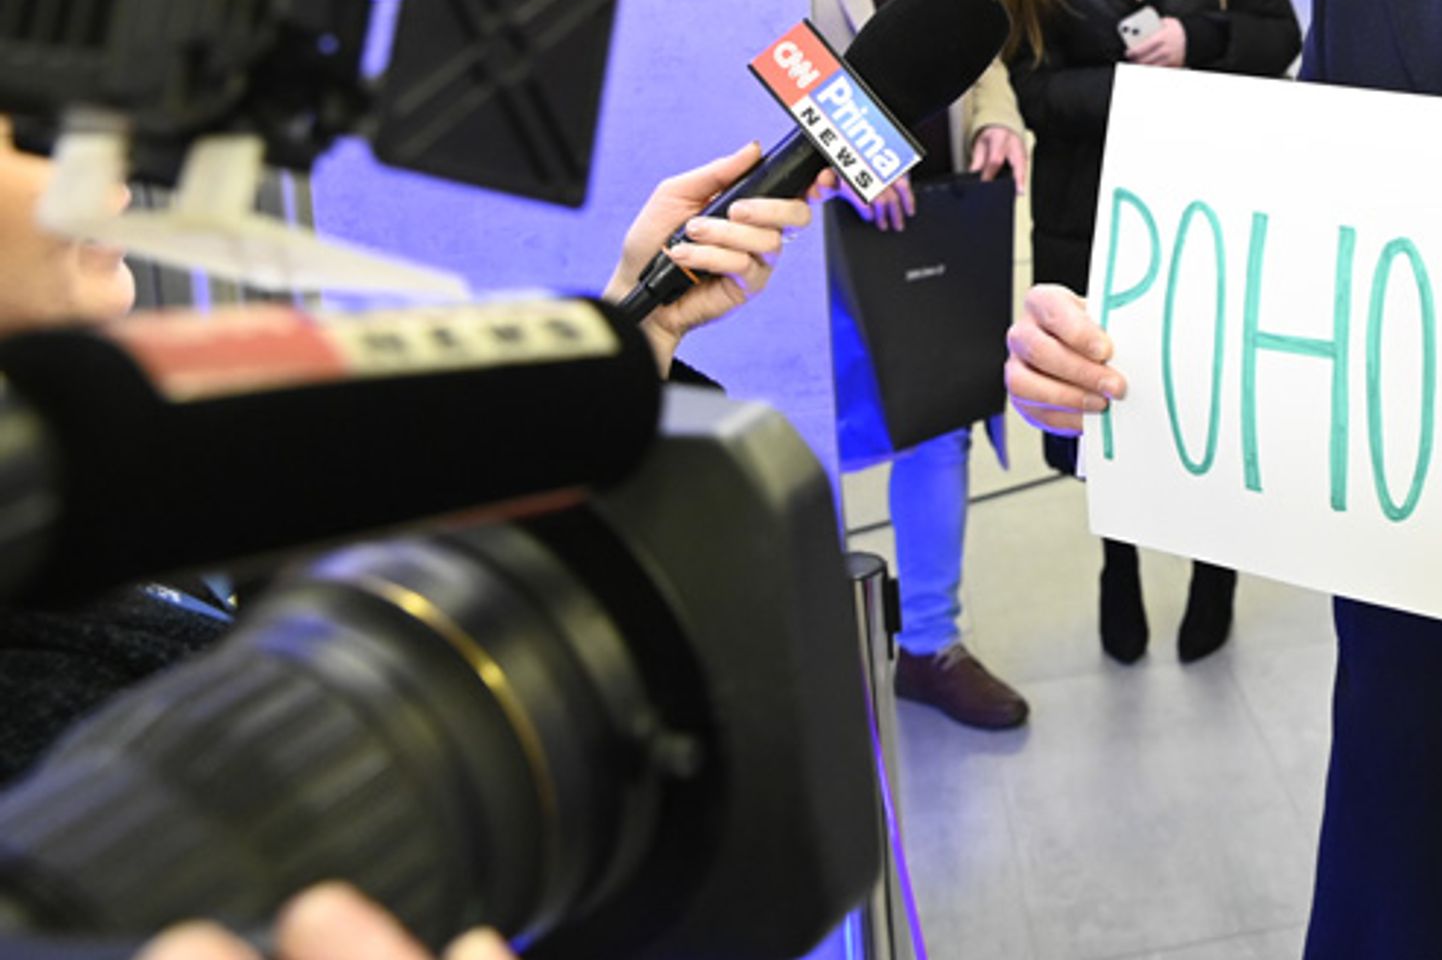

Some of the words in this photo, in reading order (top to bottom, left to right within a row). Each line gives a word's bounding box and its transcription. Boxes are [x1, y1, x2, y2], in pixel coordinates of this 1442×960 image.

[772, 40, 822, 90] CNN
[815, 74, 902, 180] Prima
[800, 106, 875, 190] NEWS
